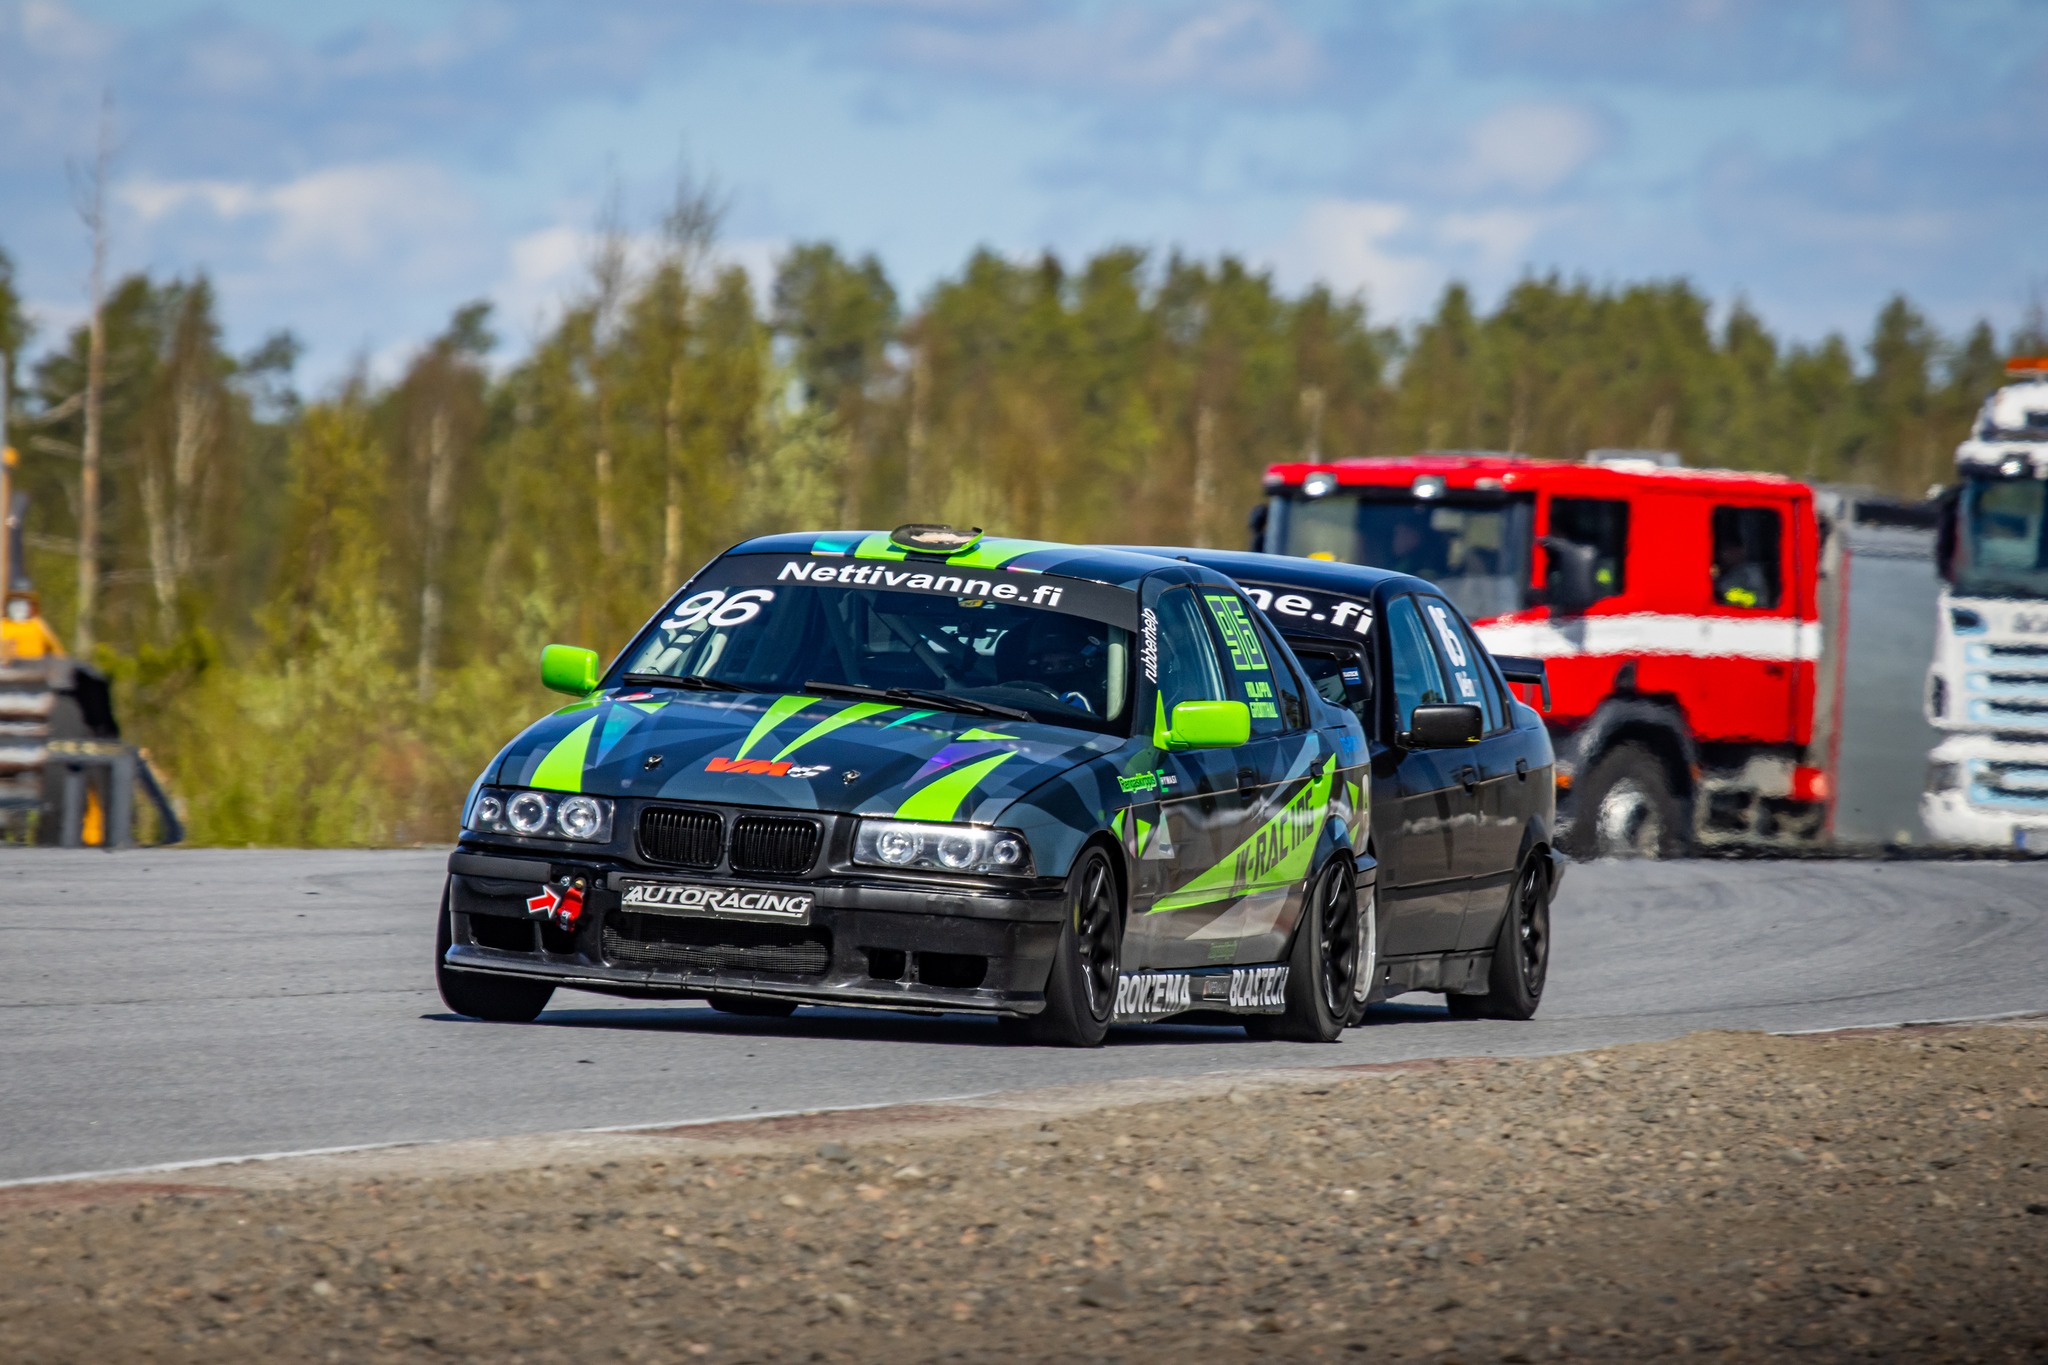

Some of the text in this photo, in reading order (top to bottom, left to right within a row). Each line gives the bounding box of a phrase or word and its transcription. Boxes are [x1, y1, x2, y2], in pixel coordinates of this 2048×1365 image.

[777, 560, 1063, 607] Nettivanne.fi
[660, 588, 775, 631] 96
[1140, 607, 1159, 684] rubberhelp
[1204, 594, 1269, 671] 96
[623, 884, 812, 914] AUTORACING
[1229, 966, 1290, 1007] BLASTECH
